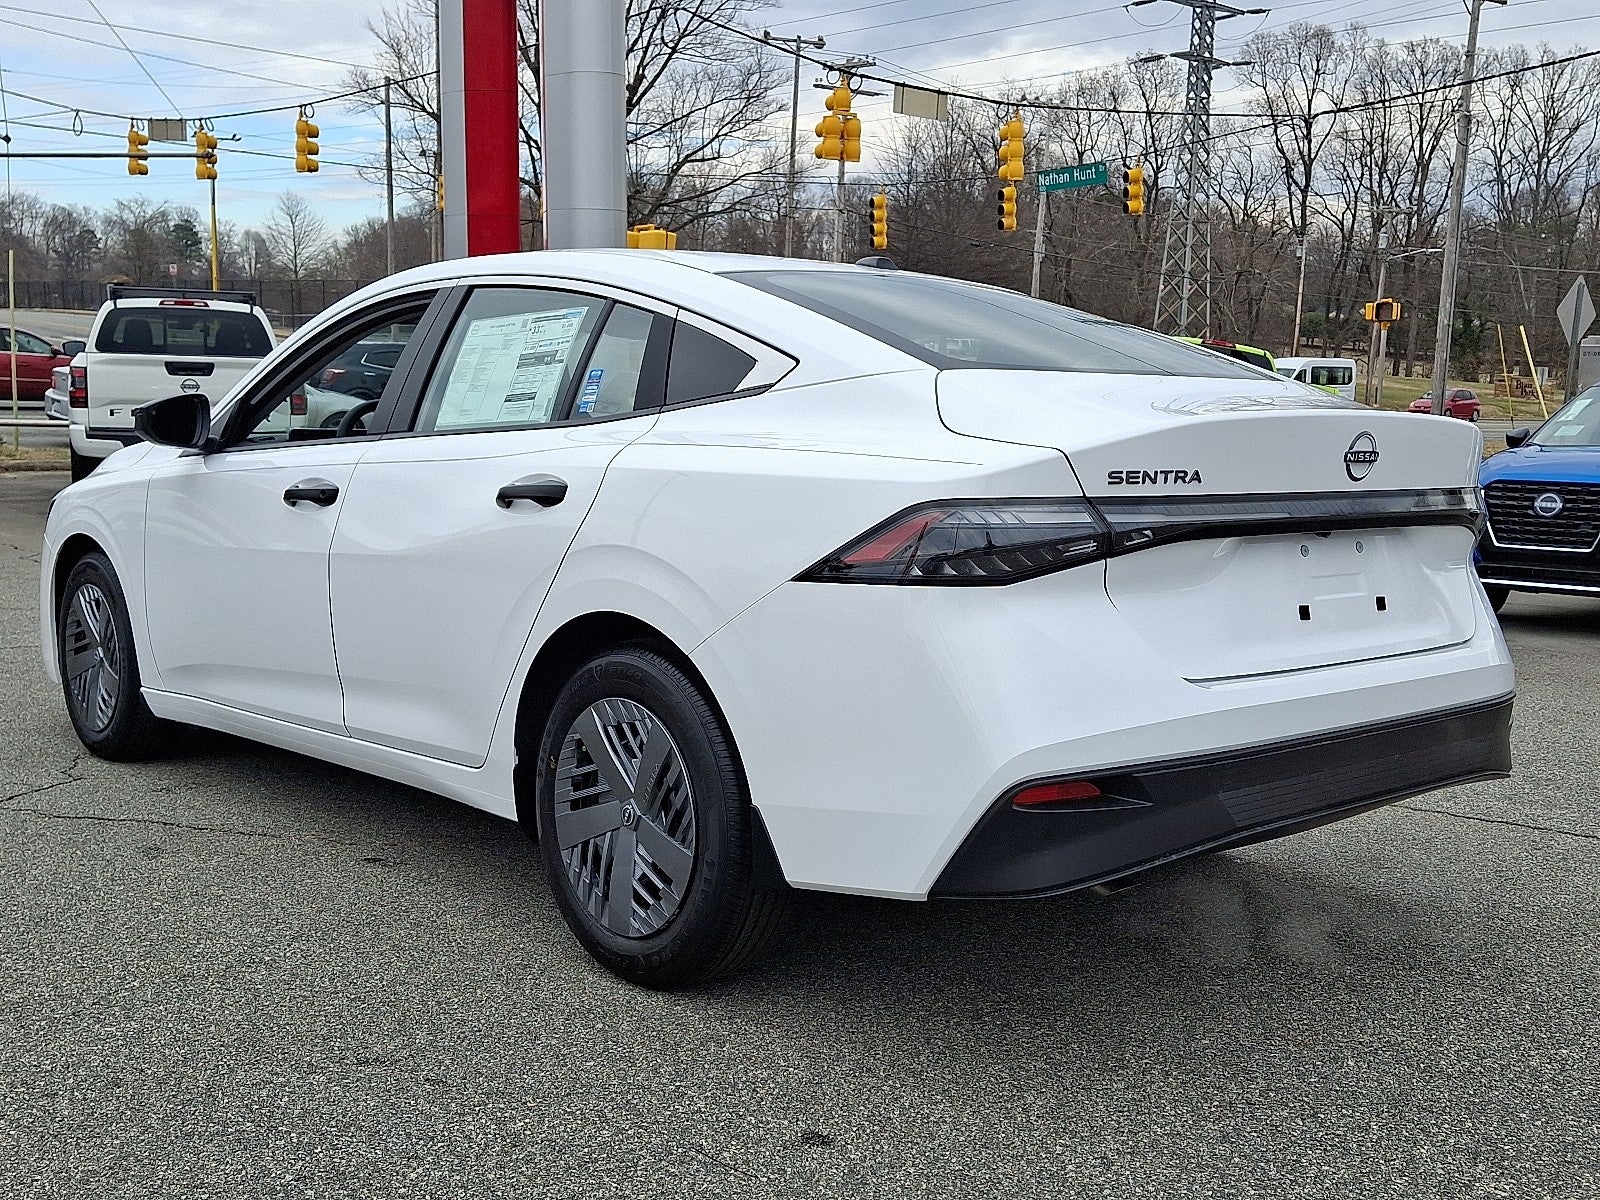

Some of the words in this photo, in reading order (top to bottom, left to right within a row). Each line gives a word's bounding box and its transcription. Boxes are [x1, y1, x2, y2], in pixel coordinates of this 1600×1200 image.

[1038, 173, 1070, 186] Nathan
[1074, 166, 1096, 181] Hunt
[1107, 469, 1203, 486] SENTRA
